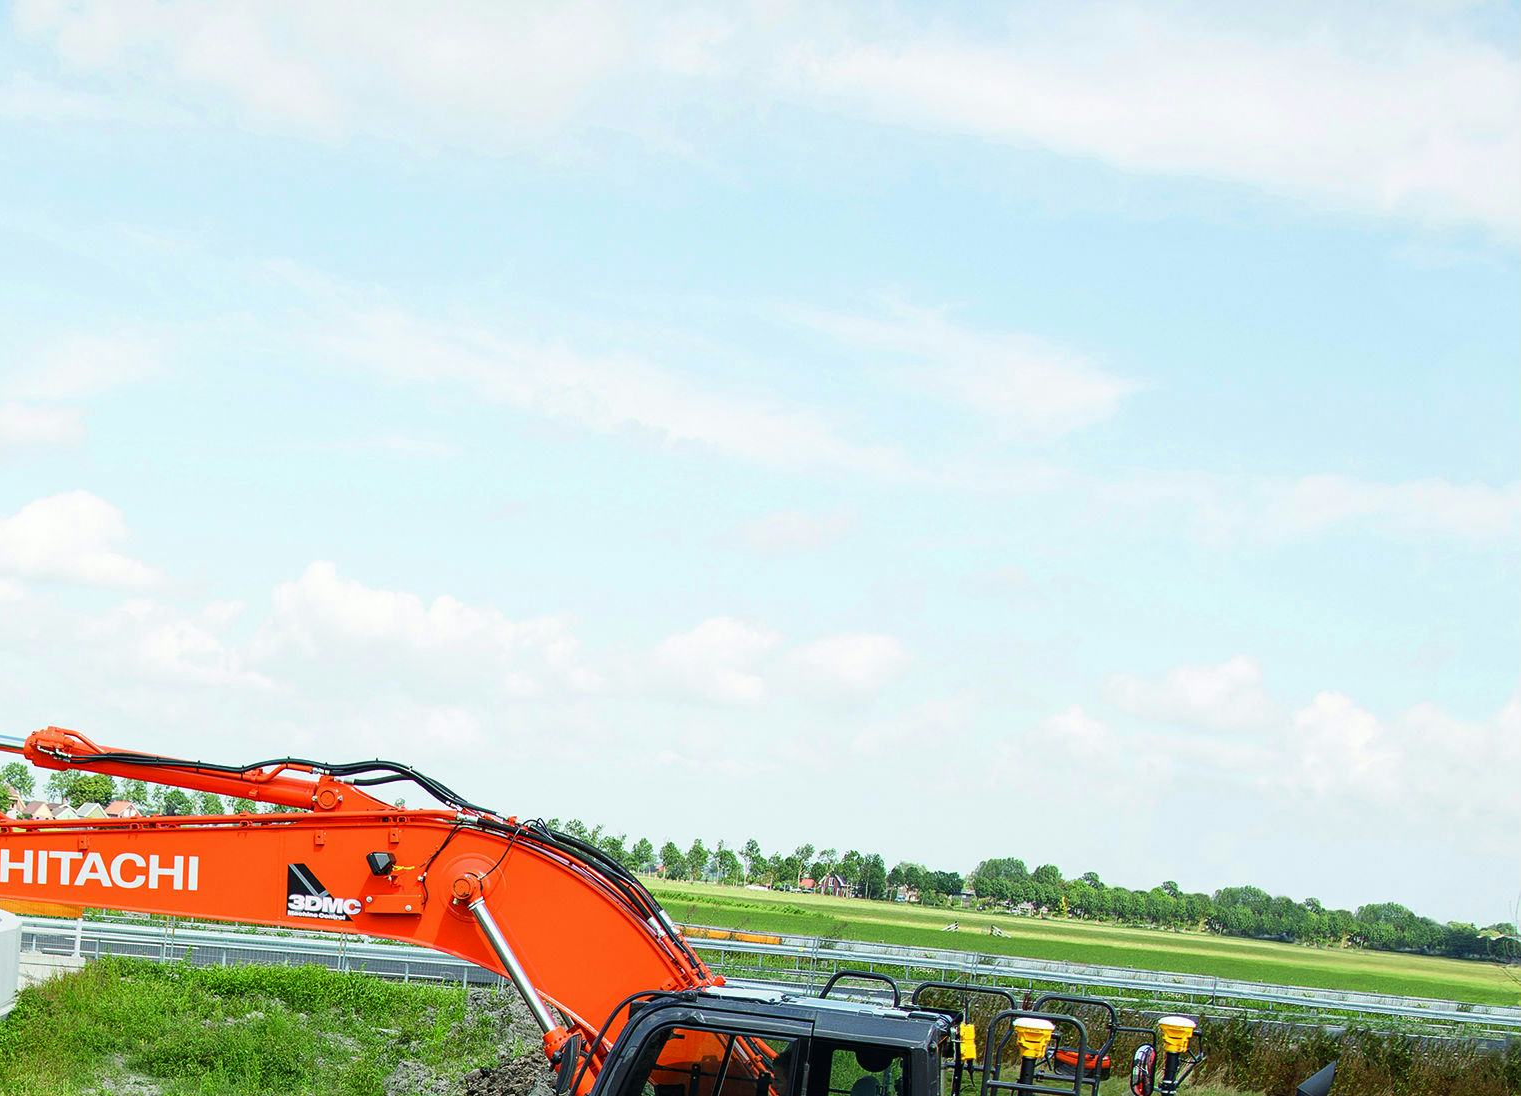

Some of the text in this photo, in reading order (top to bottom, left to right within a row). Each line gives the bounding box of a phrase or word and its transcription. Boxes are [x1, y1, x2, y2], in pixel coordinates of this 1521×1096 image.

[0, 848, 199, 891] HITACHI
[287, 894, 362, 915] 3DMC
[287, 909, 346, 921] Machine Control
